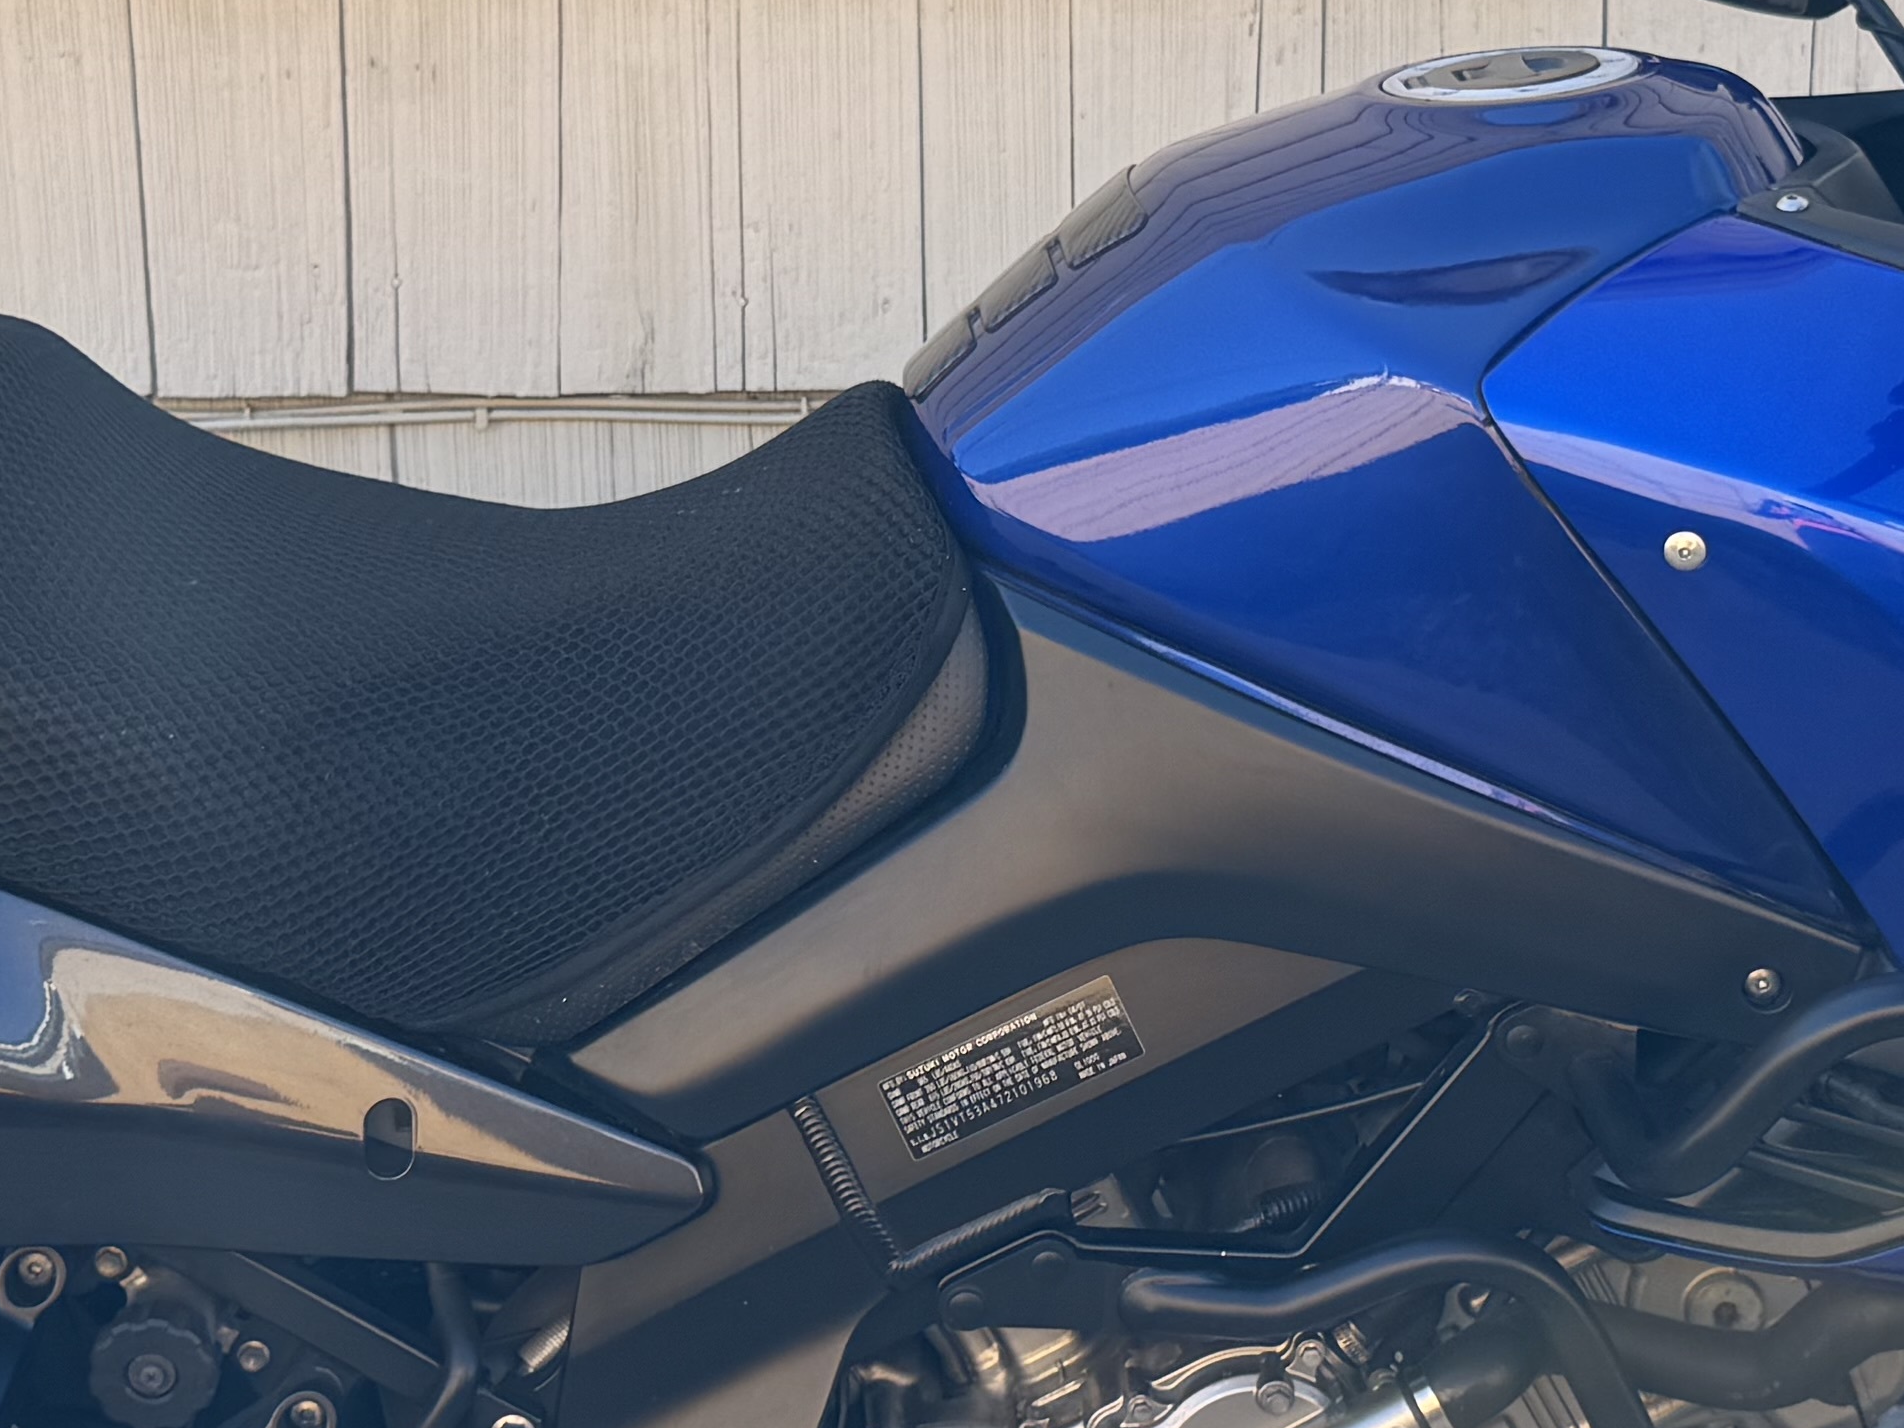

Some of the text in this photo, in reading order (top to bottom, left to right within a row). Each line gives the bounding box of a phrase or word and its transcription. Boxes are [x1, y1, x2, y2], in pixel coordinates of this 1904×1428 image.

[906, 1059, 939, 1079] SUZUKI
[941, 1043, 972, 1062] MOTOR
[975, 1013, 1037, 1047] CORPORATION
